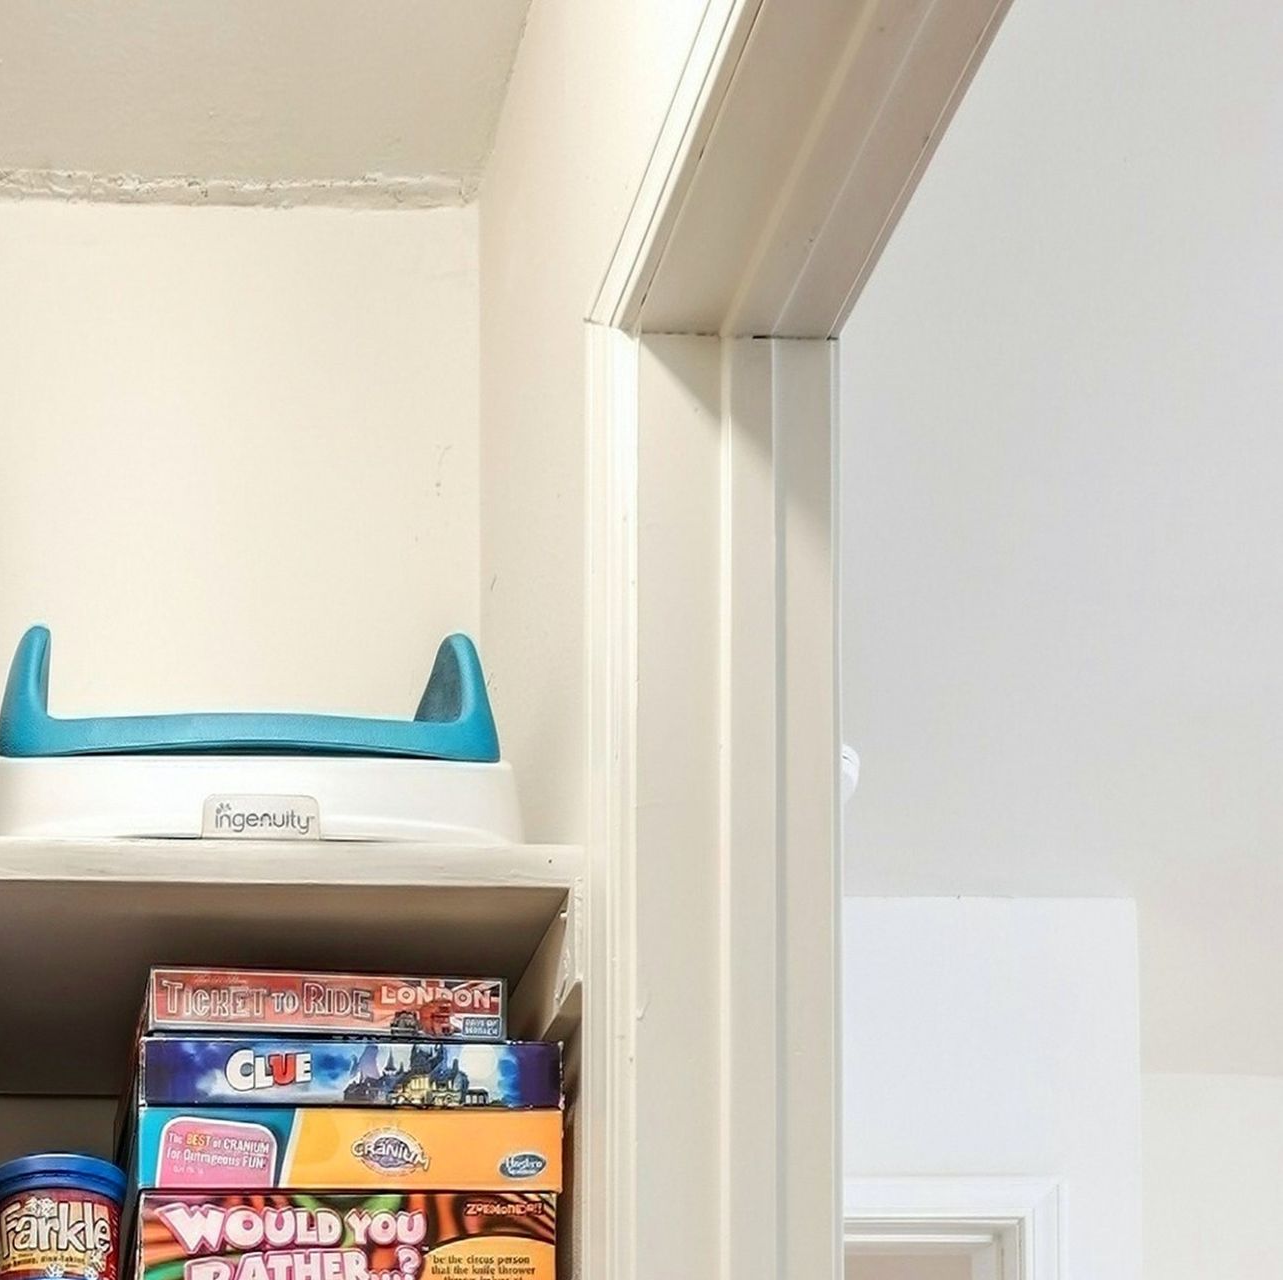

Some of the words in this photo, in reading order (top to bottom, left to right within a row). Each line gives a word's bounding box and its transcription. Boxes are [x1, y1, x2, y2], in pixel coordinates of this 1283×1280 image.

[215, 803, 310, 835] ingenuity
[162, 980, 267, 1017] TICKET
[271, 991, 299, 1015] TO
[303, 981, 373, 1020] RIDE
[381, 985, 491, 1009] LONDON
[225, 1048, 312, 1092] CLUE
[167, 1147, 181, 1159] for
[183, 1149, 240, 1165] Outrageous
[186, 1133, 210, 1145] BEST
[223, 1138, 270, 1153] CRANIUM
[0, 1199, 113, 1260] Farkle
[155, 1203, 342, 1254] WOULD
[344, 1207, 428, 1246] YOU
[431, 1265, 450, 1275] that
[453, 1265, 468, 1275] the
[471, 1265, 495, 1275] knife
[498, 1266, 535, 1275] thrower
[433, 1255, 445, 1264] be
[448, 1255, 463, 1264] the
[466, 1255, 494, 1265] circus
[497, 1256, 530, 1266] person
